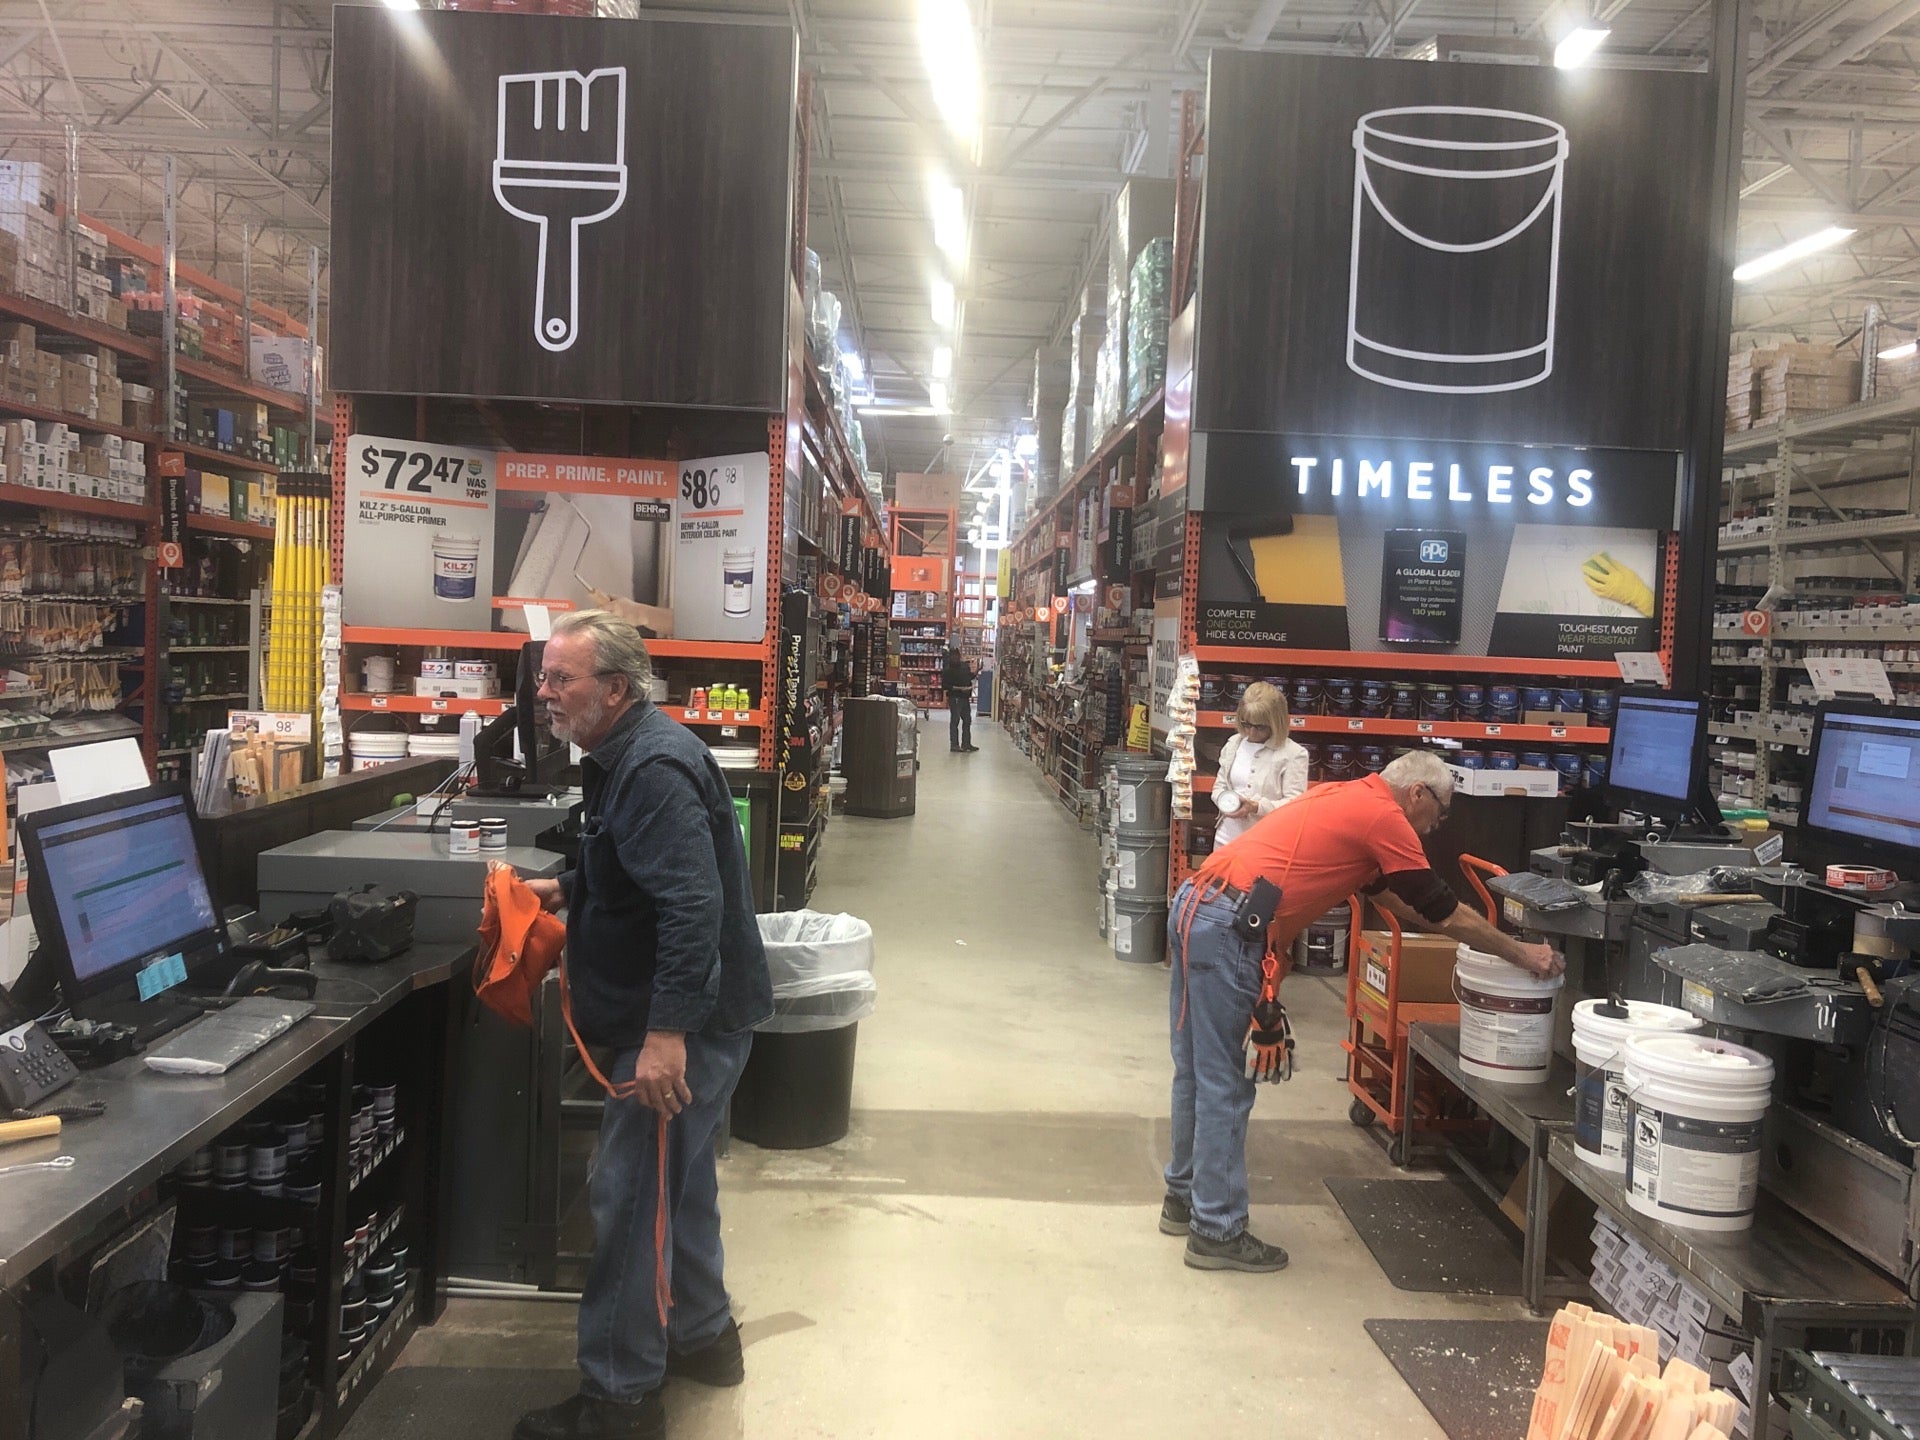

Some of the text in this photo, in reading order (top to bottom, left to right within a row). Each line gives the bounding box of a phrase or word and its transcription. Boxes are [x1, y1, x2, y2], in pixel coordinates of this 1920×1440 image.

[505, 462, 667, 486] PREP. PRIME. PAINT.
[466, 477, 487, 488] WAS
[1290, 456, 1594, 507] TIMELESS
[169, 479, 178, 511] Brushes
[360, 500, 377, 510] KILZ
[390, 504, 431, 515] 5-GALLON
[635, 503, 659, 513] BEHR
[359, 510, 447, 526] ALL-PURPOSE PRIMER
[1116, 509, 1125, 535] Primer
[696, 521, 719, 530] 5-GALLON
[847, 517, 855, 543] Weather
[171, 520, 180, 543] Roller
[680, 529, 738, 540] INTERIOR CEILING PAINT
[1422, 542, 1447, 560] PPG
[443, 561, 468, 571] KILZ
[1395, 568, 1402, 576] A
[1402, 568, 1436, 577] GLOBAL
[1206, 608, 1256, 619] COMPLETE
[1206, 619, 1252, 630] ONE COAT
[1558, 623, 1639, 635] TOUGHEST, MOST
[1205, 630, 1287, 642] HIDE & COVERAGE
[1557, 633, 1636, 645] WEAR RESISTANT
[1557, 644, 1584, 654] PAINT
[422, 664, 444, 674] ILZ 2
[459, 664, 484, 673] KILZ
[789, 736, 805, 747] 3M
